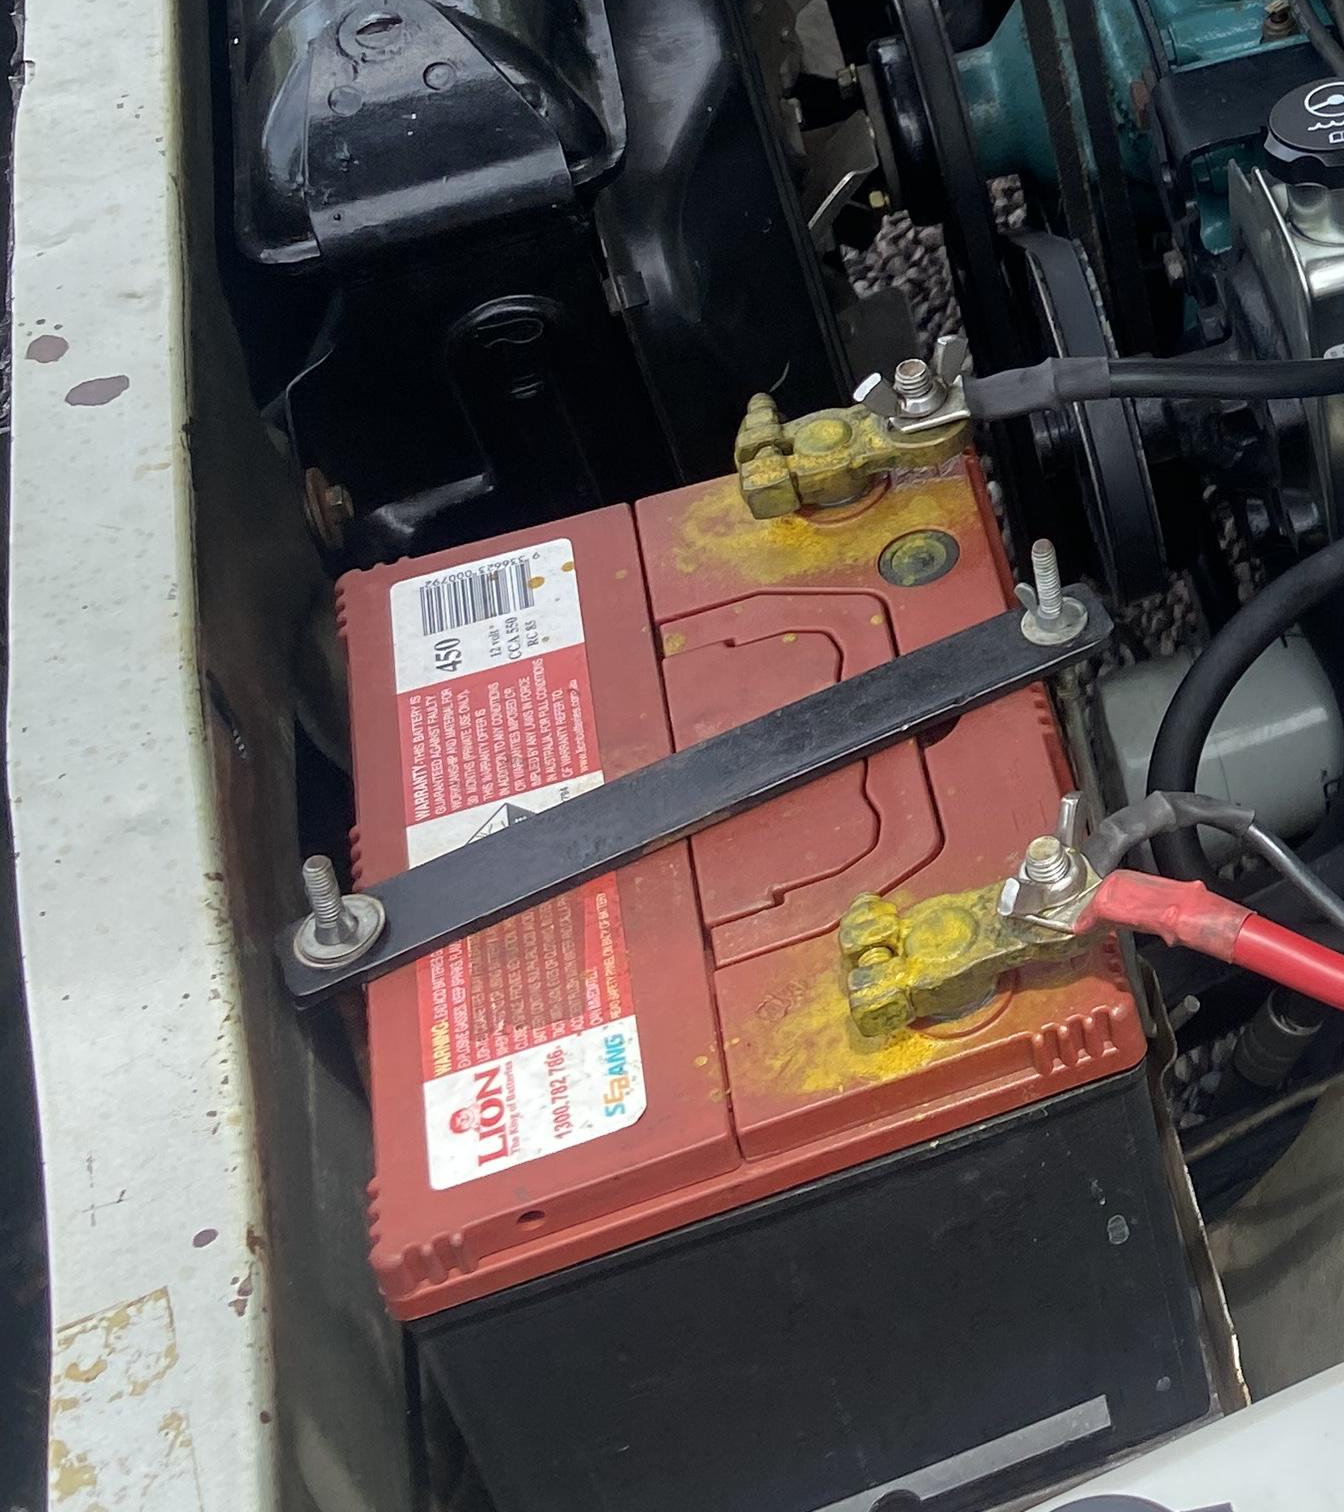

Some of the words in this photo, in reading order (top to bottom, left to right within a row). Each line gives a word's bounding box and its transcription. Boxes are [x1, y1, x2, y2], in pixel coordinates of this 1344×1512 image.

[487, 628, 501, 646] volt
[504, 615, 519, 635] 550
[525, 630, 539, 647] RC
[434, 636, 461, 675] 450
[488, 645, 502, 658] 12
[506, 633, 522, 661] CCA
[518, 674, 532, 702] FORCE
[531, 656, 548, 701] CONDITIONS
[424, 692, 440, 725] FAULTY
[440, 686, 453, 704] FOR
[487, 680, 503, 727] CONDITIONS
[407, 702, 425, 744] BATTERY
[441, 701, 456, 739] MATERIAL
[458, 711, 474, 730] USE
[504, 697, 520, 732] IMPOSED
[522, 709, 536, 731] LAWS
[538, 715, 552, 734] FOR
[552, 699, 568, 726] REFER
[427, 723, 442, 760] AGAINST
[474, 714, 489, 742] OFFER
[491, 723, 505, 743] ANY
[524, 729, 538, 747] ANY
[444, 736, 458, 755] AND
[508, 729, 525, 779] WARRANTIES
[555, 723, 573, 766] WARRANTY
[476, 739, 493, 783] WARRANTY
[493, 750, 509, 789] ADDITION
[527, 755, 542, 787] IMPLIED
[429, 757, 447, 816] GUARANTEED
[462, 759, 480, 795] MONTHS
[480, 781, 495, 802] THIS
[594, 890, 609, 920] BATTERY
[504, 1061, 516, 1102] Batteries
[474, 1065, 508, 1166] LION
[509, 1112, 522, 1135] King
[510, 1136, 520, 1155] The
